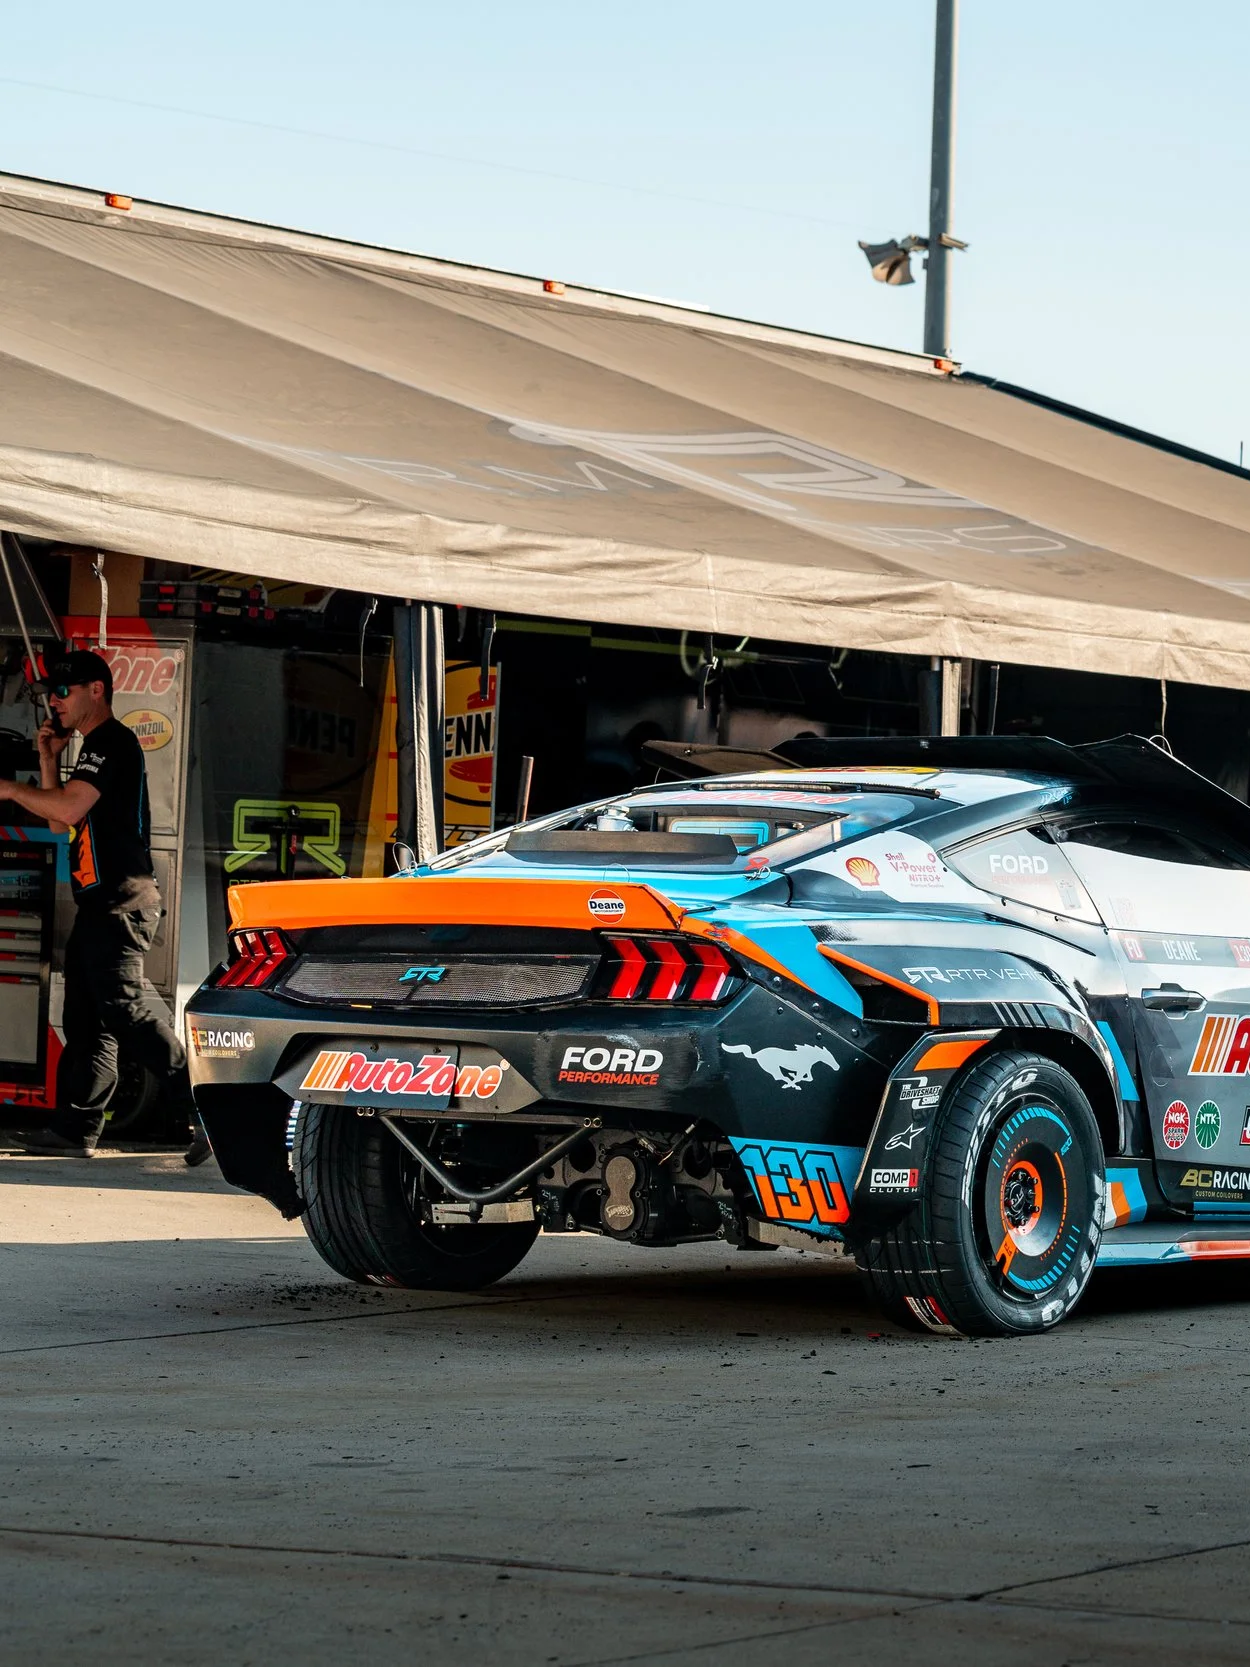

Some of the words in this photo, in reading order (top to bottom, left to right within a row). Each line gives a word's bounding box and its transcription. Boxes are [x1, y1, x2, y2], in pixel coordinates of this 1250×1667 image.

[885, 852, 905, 861] Shell
[890, 861, 936, 872] V-Power
[989, 854, 1049, 874] FORD
[589, 901, 624, 910] Deane
[1124, 938, 1143, 958] FD
[1162, 939, 1201, 961] DEANE
[208, 1030, 254, 1048] RACING
[560, 1046, 663, 1073] FORD
[339, 1051, 502, 1099] AutoZone
[557, 1070, 660, 1086] PERFORMANCE
[901, 1087, 941, 1099] DRIVESHAFT
[1168, 1113, 1185, 1124] NGK
[1200, 1114, 1216, 1125] NTK
[874, 1172, 908, 1183] COMP
[738, 1143, 853, 1225] 130
[1195, 1190, 1216, 1198] CUSTOM
[1216, 1191, 1244, 1200] COILOVERS
